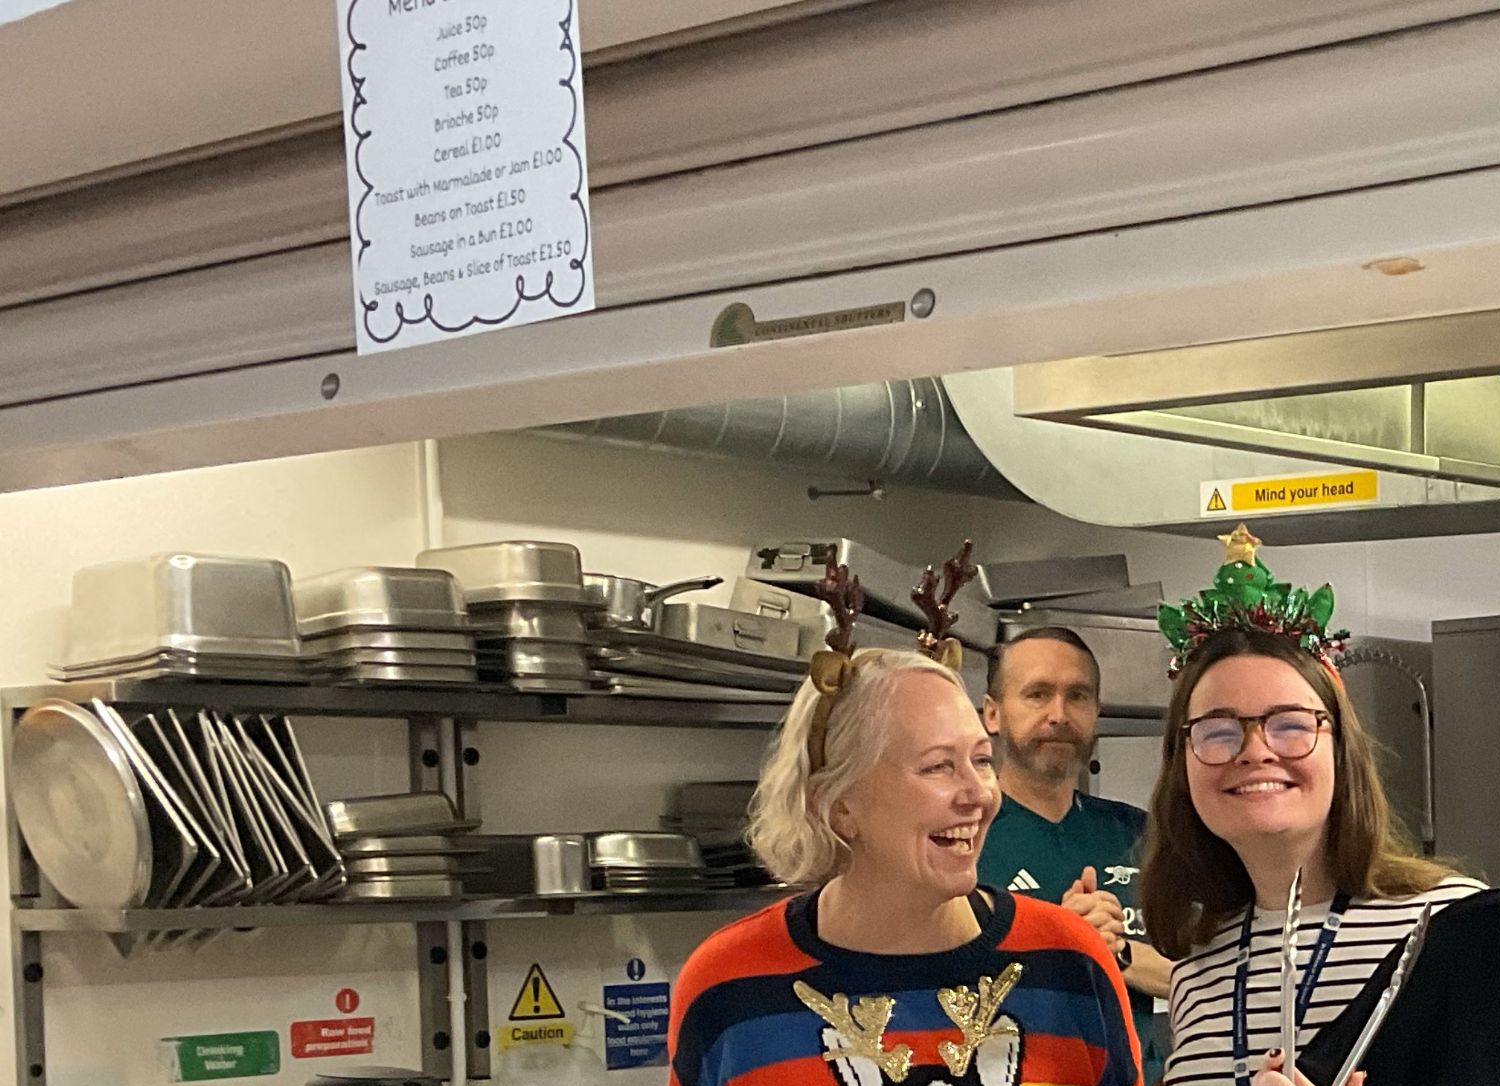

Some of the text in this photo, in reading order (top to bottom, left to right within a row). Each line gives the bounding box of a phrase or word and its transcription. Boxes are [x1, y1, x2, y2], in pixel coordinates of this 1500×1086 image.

[436, 15, 487, 41] Juice 50p
[434, 44, 495, 72] Coffee 50p
[444, 77, 488, 100] Tea 50p
[434, 104, 499, 132] Brioche 50p
[434, 132, 501, 162] Cereal £1.00
[374, 147, 562, 205] Toast with Marmalade or Jam £1.00
[415, 188, 526, 227] Beans on Toast £1.50
[410, 218, 533, 258] Sausage in a Bun £2.00
[374, 277, 421, 295] Sausage,
[423, 269, 455, 286] Beans
[466, 259, 491, 278] Slice
[493, 253, 504, 270] of
[507, 250, 537, 268] Toast
[539, 240, 572, 261] £2.50
[1255, 481, 1354, 503] Mind your head
[511, 1027, 564, 1041] Caution
